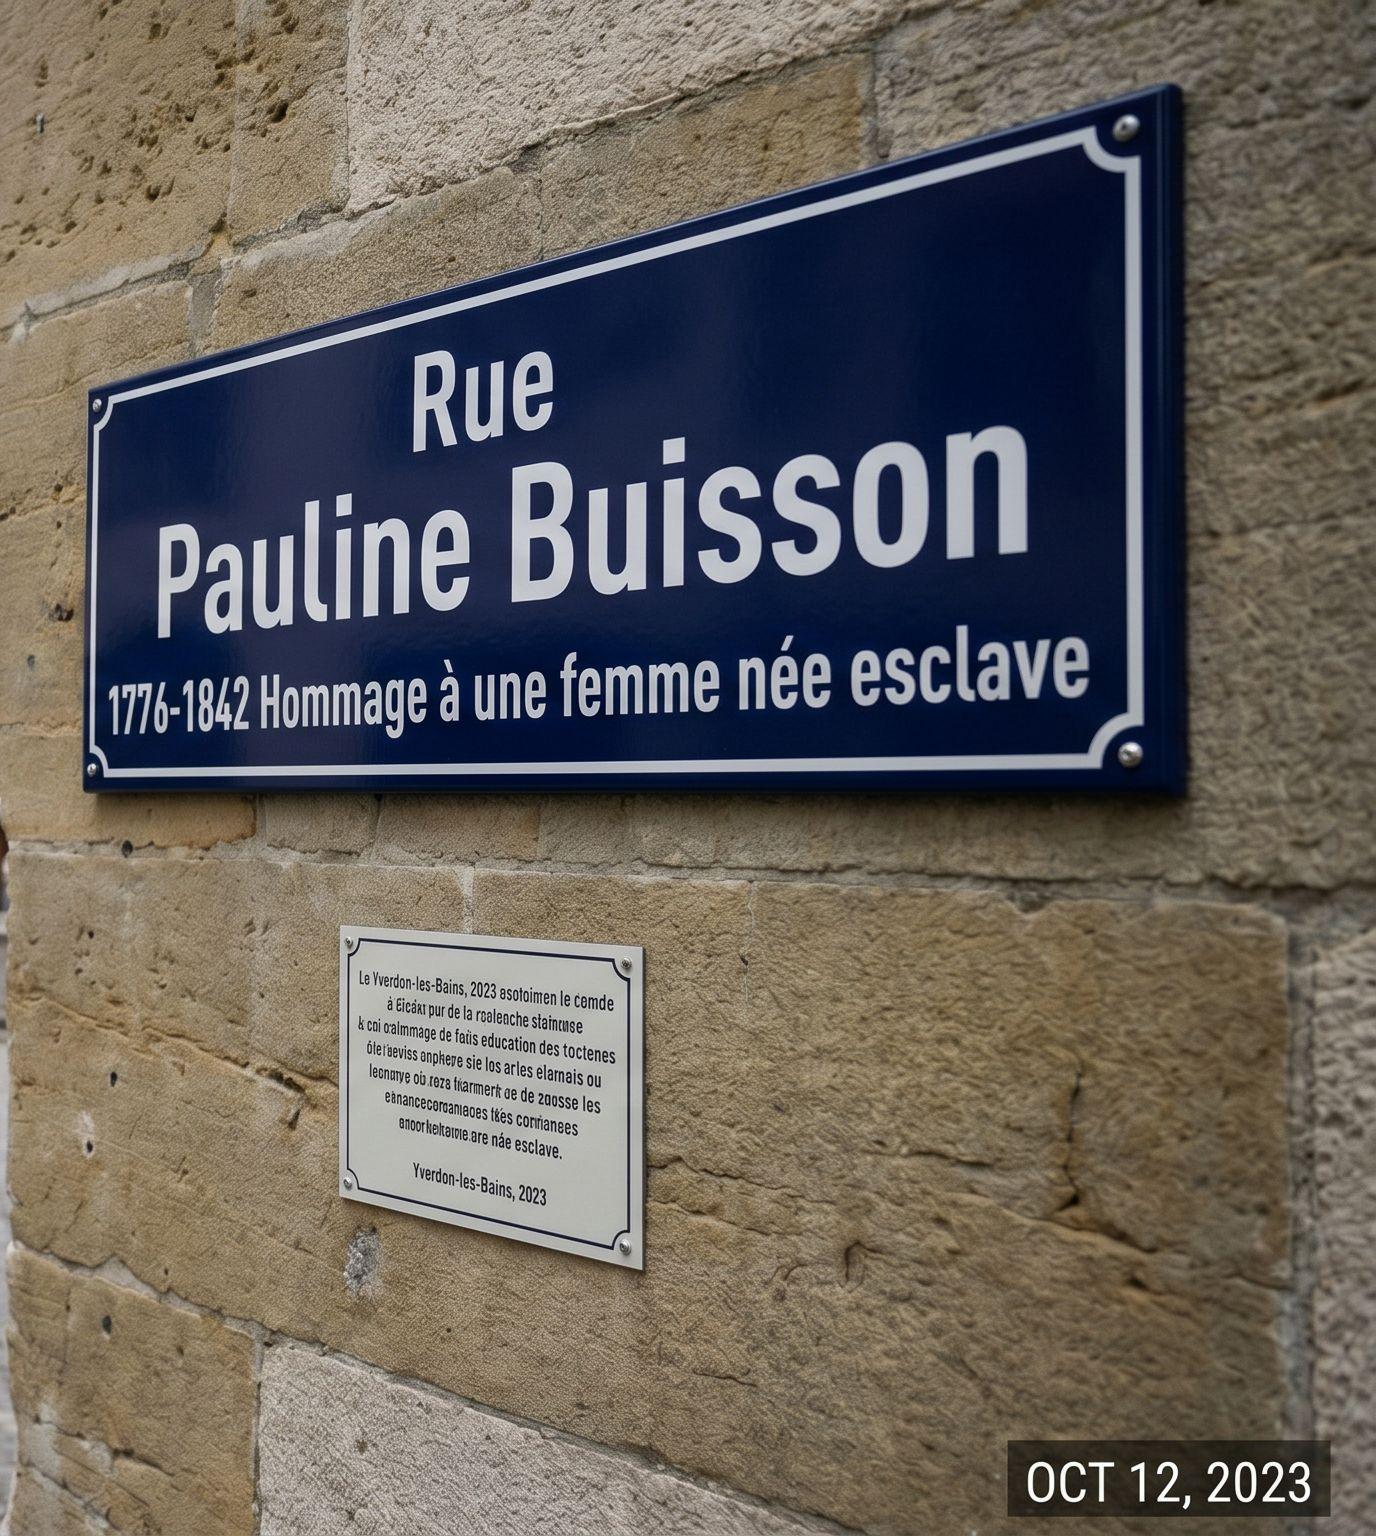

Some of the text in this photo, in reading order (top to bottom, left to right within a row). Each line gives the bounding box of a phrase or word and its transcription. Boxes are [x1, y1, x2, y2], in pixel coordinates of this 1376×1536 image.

[413, 350, 554, 452] Rue
[157, 425, 1028, 639] Pauline Buisson
[108, 625, 1090, 739] 1776-1842 Hommage à une femme née esclave
[359, 970, 370, 985] Le
[373, 971, 467, 998] Yverdon-les-Bains,
[471, 981, 497, 999] 2023
[560, 990, 571, 1007] le
[429, 1004, 446, 1019] pur
[448, 1004, 460, 1019] de
[463, 1005, 473, 1021] la
[439, 1027, 452, 1042] de
[481, 1032, 536, 1054] education
[539, 1040, 560, 1057] des
[466, 1055, 483, 1071] sie
[485, 1056, 501, 1074] los
[587, 1073, 602, 1088] ou
[520, 1086, 535, 1104] de
[582, 1095, 601, 1114] les
[514, 1139, 563, 1160] esclave.
[413, 1162, 547, 1206] Yverdon-les-Bains, 2023
